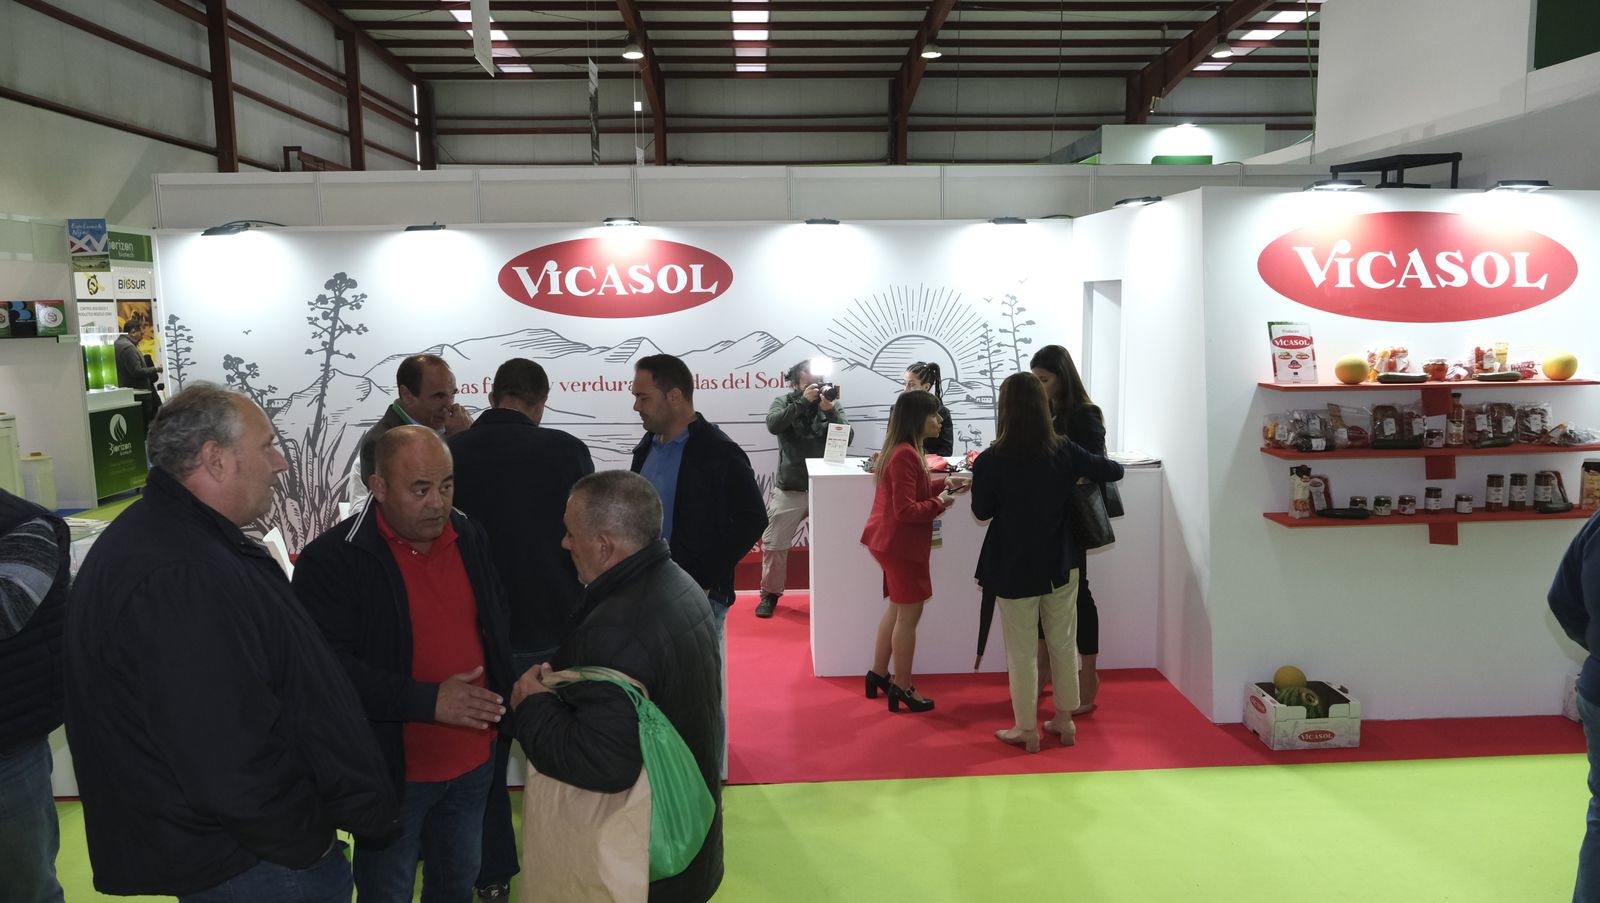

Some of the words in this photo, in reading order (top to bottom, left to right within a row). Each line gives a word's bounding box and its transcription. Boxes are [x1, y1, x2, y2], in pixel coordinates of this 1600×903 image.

[457, 383, 478, 394] as
[559, 375, 633, 392] verdura
[722, 372, 750, 389] del
